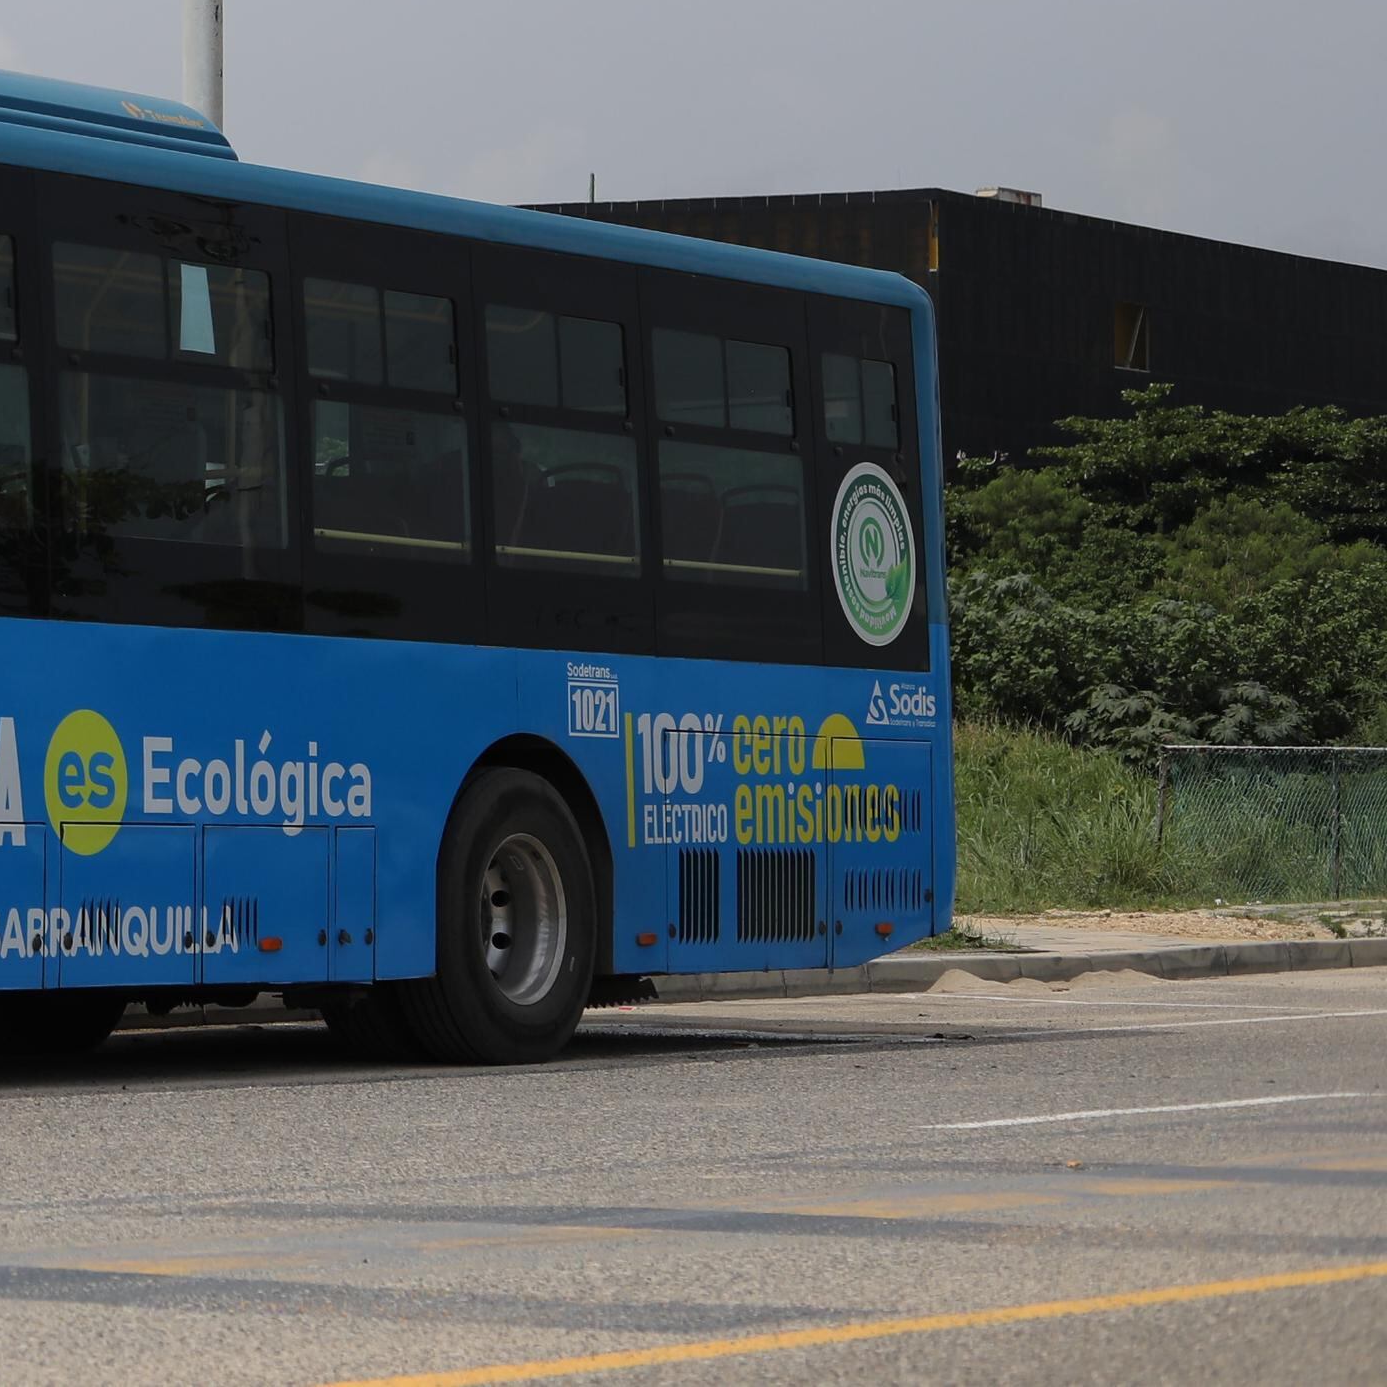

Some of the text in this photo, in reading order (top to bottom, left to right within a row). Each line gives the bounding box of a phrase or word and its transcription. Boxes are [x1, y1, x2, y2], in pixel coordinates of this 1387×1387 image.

[567, 662, 611, 679] Sodetrans
[571, 688, 616, 732] 1021
[889, 683, 936, 717] Sodis
[637, 712, 806, 795] 100% cero
[58, 750, 116, 810] es
[142, 728, 372, 837] Ecológica
[643, 781, 901, 846] ELÉCTRICO emisiones
